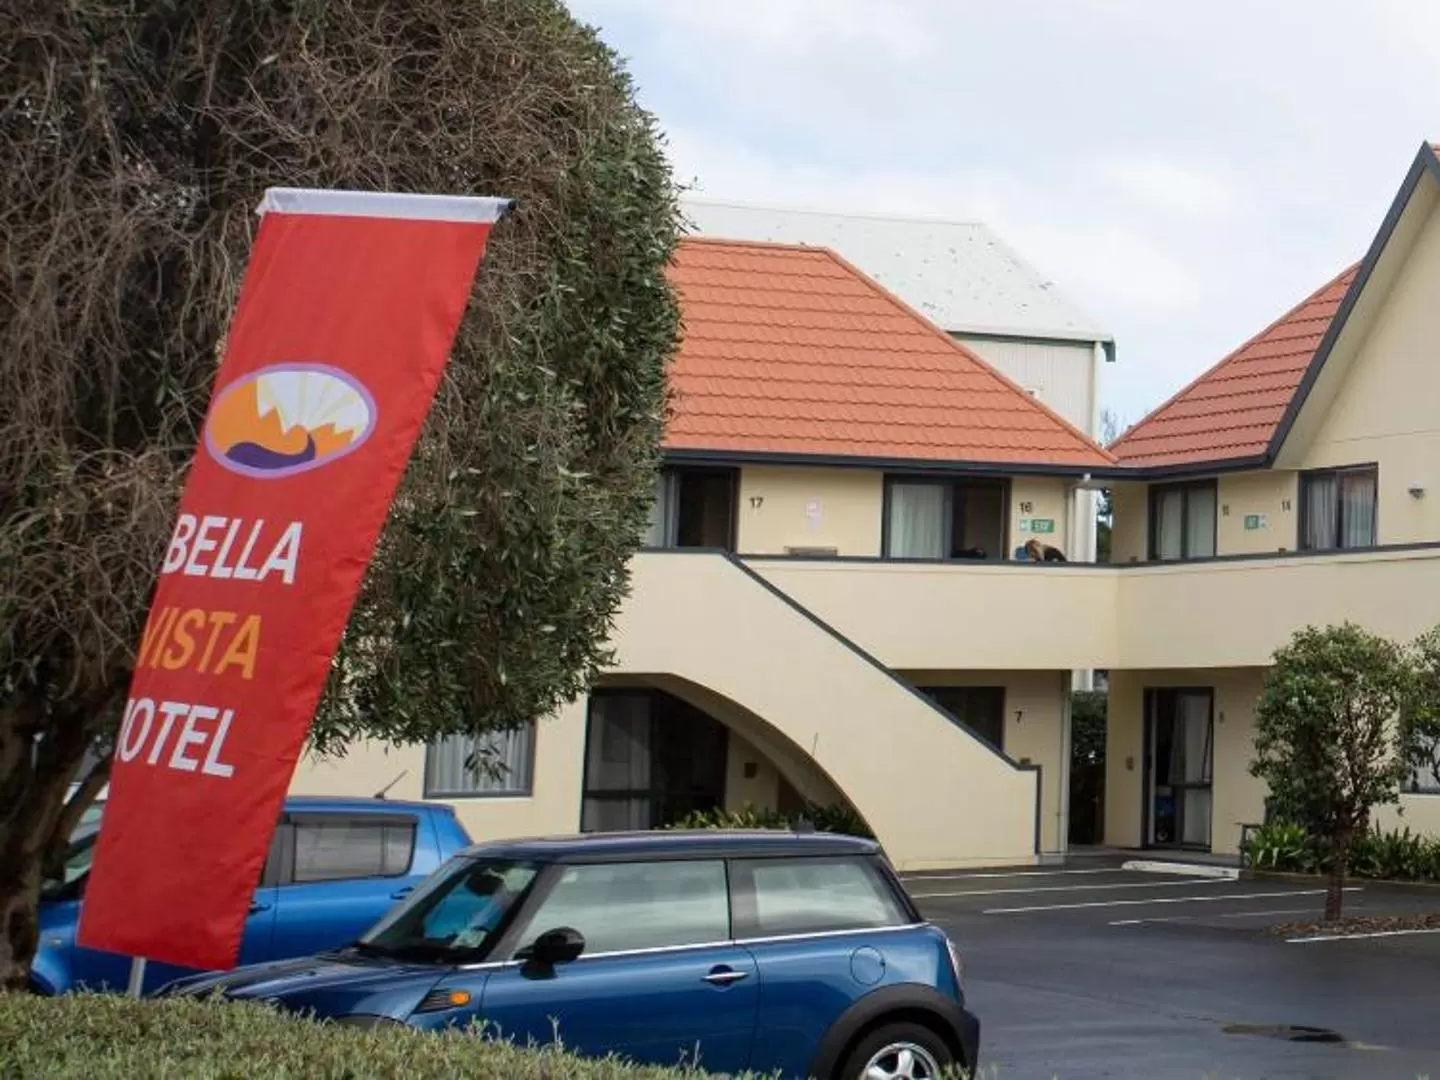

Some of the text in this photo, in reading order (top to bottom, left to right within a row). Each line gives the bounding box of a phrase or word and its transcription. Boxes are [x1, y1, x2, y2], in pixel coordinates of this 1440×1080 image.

[749, 496, 765, 509] 17
[162, 514, 303, 585] BELLA
[115, 697, 235, 777] OTEL
